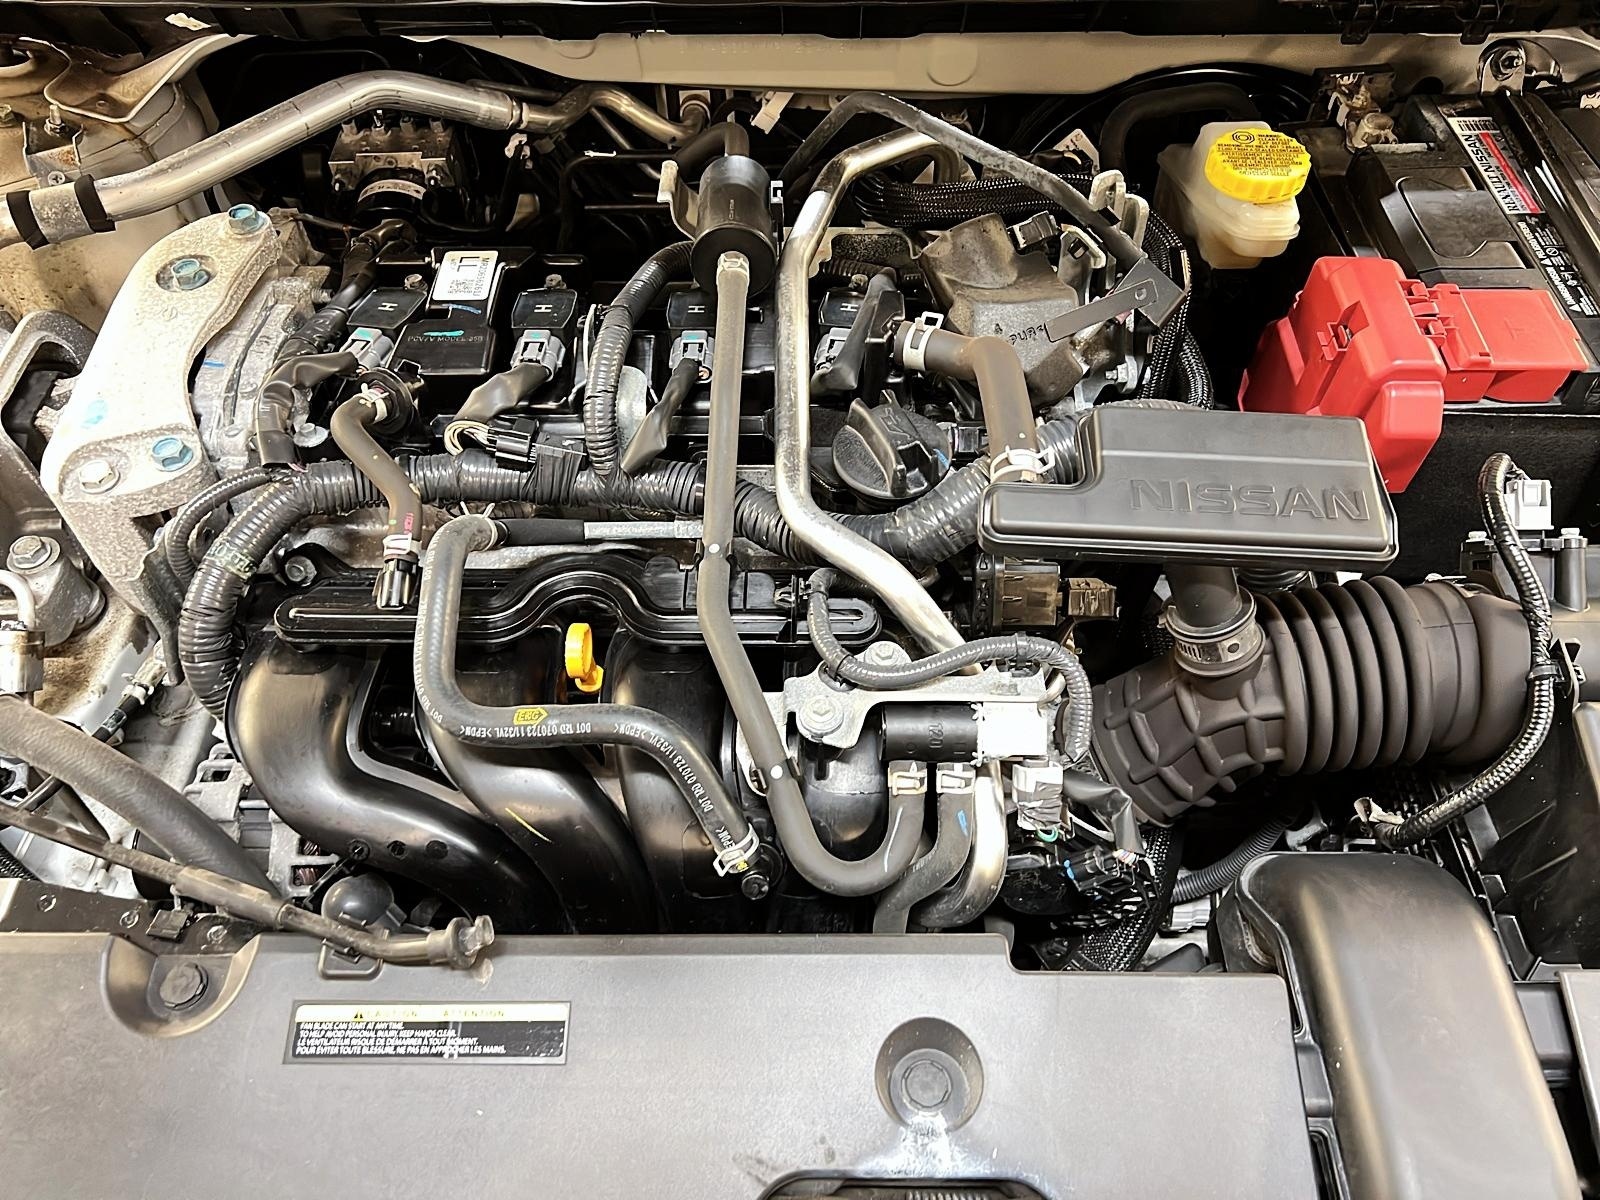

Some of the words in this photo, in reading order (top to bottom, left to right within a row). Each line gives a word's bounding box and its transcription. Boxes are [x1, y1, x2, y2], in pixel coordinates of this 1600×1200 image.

[1461, 134, 1495, 173] NISSAN
[1487, 174, 1520, 212] RENAULT
[1129, 478, 1371, 521] NISSAN
[526, 724, 558, 737] 070723
[576, 722, 592, 734] DOT
[672, 755, 697, 784] 070723
[699, 796, 714, 812] DOT
[300, 1029, 309, 1038] TO
[309, 1029, 325, 1038] HELP
[398, 1029, 415, 1038] KEEP
[414, 1029, 437, 1038] HANDS
[297, 1037, 306, 1046] LE
[306, 1037, 351, 1046] VENTILATEUR
[350, 1037, 376, 1046] RISQUE
[376, 1037, 386, 1046] DE
[429, 1037, 446, 1046] TOUT
[296, 1045, 316, 1055] POUR
[340, 1045, 362, 1055] TOUTE
[396, 1045, 407, 1055] NE
[407, 1045, 420, 1055] PAS
[470, 1045, 482, 1055] LES
